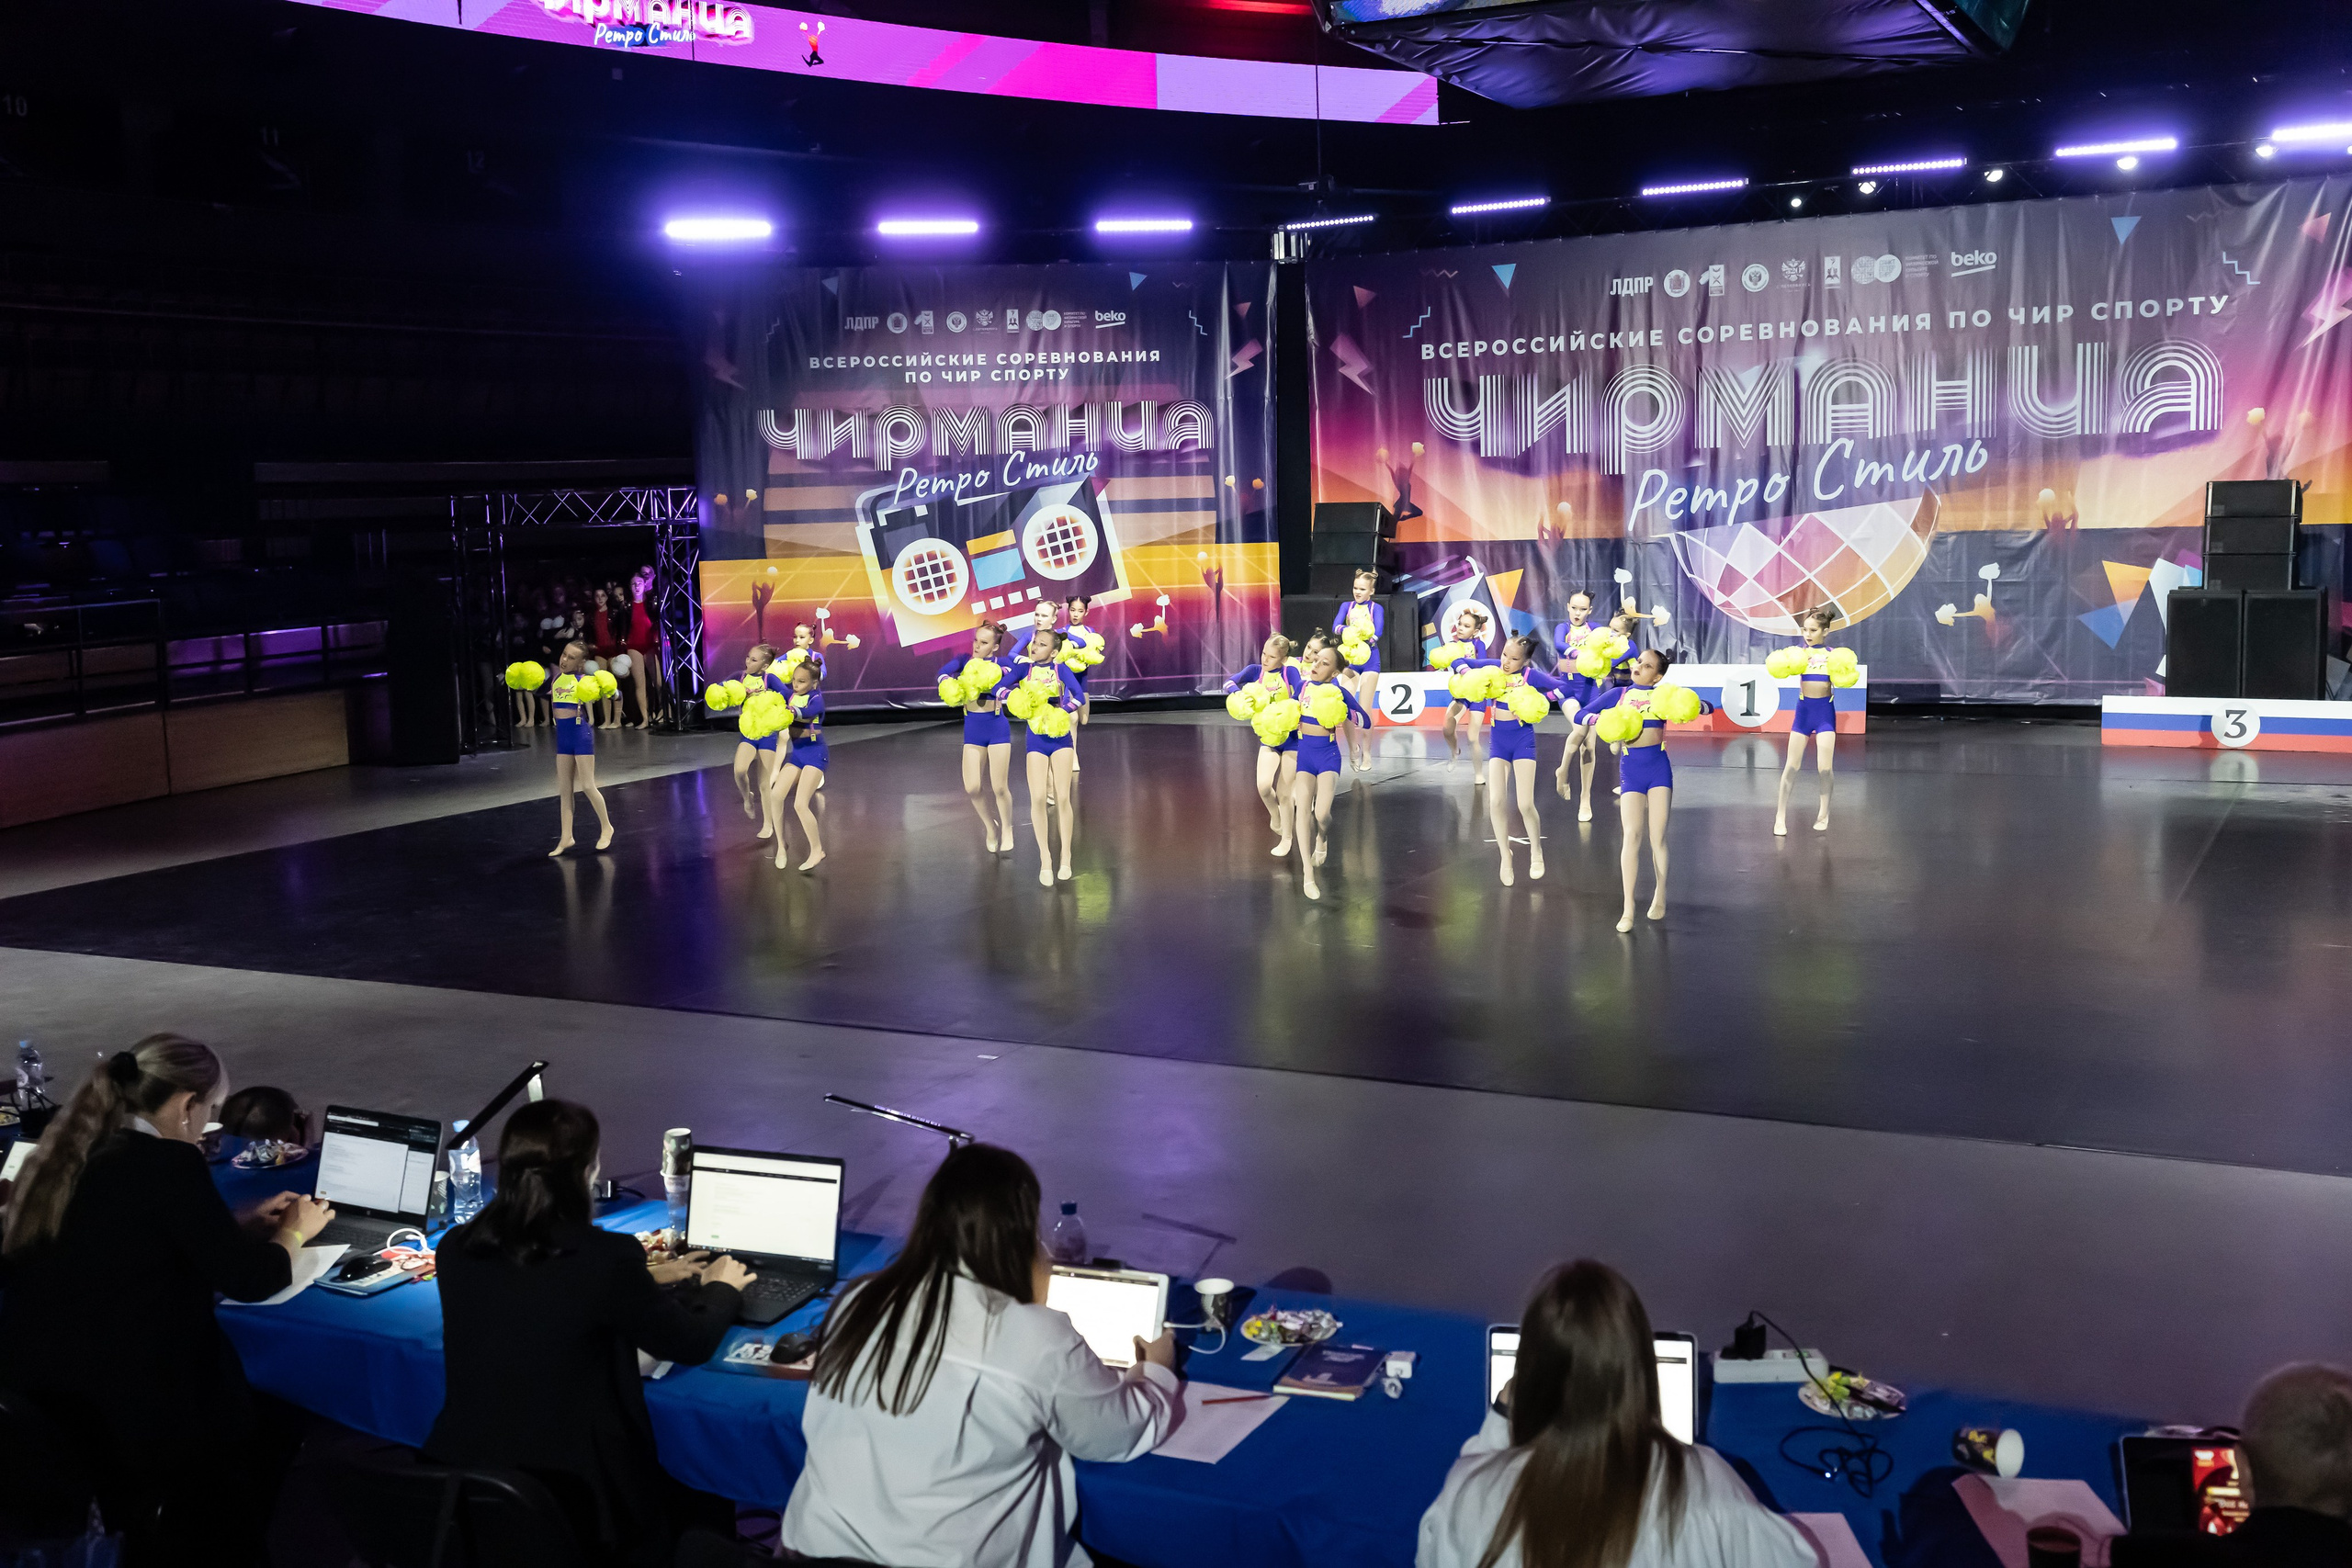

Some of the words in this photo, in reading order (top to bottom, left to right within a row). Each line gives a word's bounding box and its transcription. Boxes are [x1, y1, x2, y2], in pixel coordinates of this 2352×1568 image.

[594, 23, 643, 48] Ретро
[2, 94, 28, 117] 10
[1951, 250, 1997, 266] beko
[1610, 276, 1654, 297] ЛДПР
[844, 316, 879, 332] ЛДПР
[1094, 310, 1126, 321] beko
[1421, 329, 1663, 360] ВСЕРОССИЙСКИЕ
[1678, 312, 1930, 344] СОРЕВНОВАНИЯ
[1949, 310, 1992, 329] ПО
[2008, 304, 2074, 326] ЧИР
[2091, 295, 2229, 321] СПОРТУ
[809, 352, 987, 368] ВСЕРОССИЙСКИЕ
[996, 350, 1160, 366] СОРЕВНОВАНИЯ
[905, 371, 932, 383] ПО
[941, 370, 981, 382] ЧИР
[990, 368, 1069, 381] СПОРТУ
[894, 468, 989, 504] Ретро
[1003, 451, 1099, 487] Стиль
[1628, 468, 1791, 531] Ретро
[1813, 437, 1988, 501] Стиль
[1391, 683, 1413, 715] 2
[1740, 680, 1760, 716] 1
[2223, 709, 2247, 739] 3
